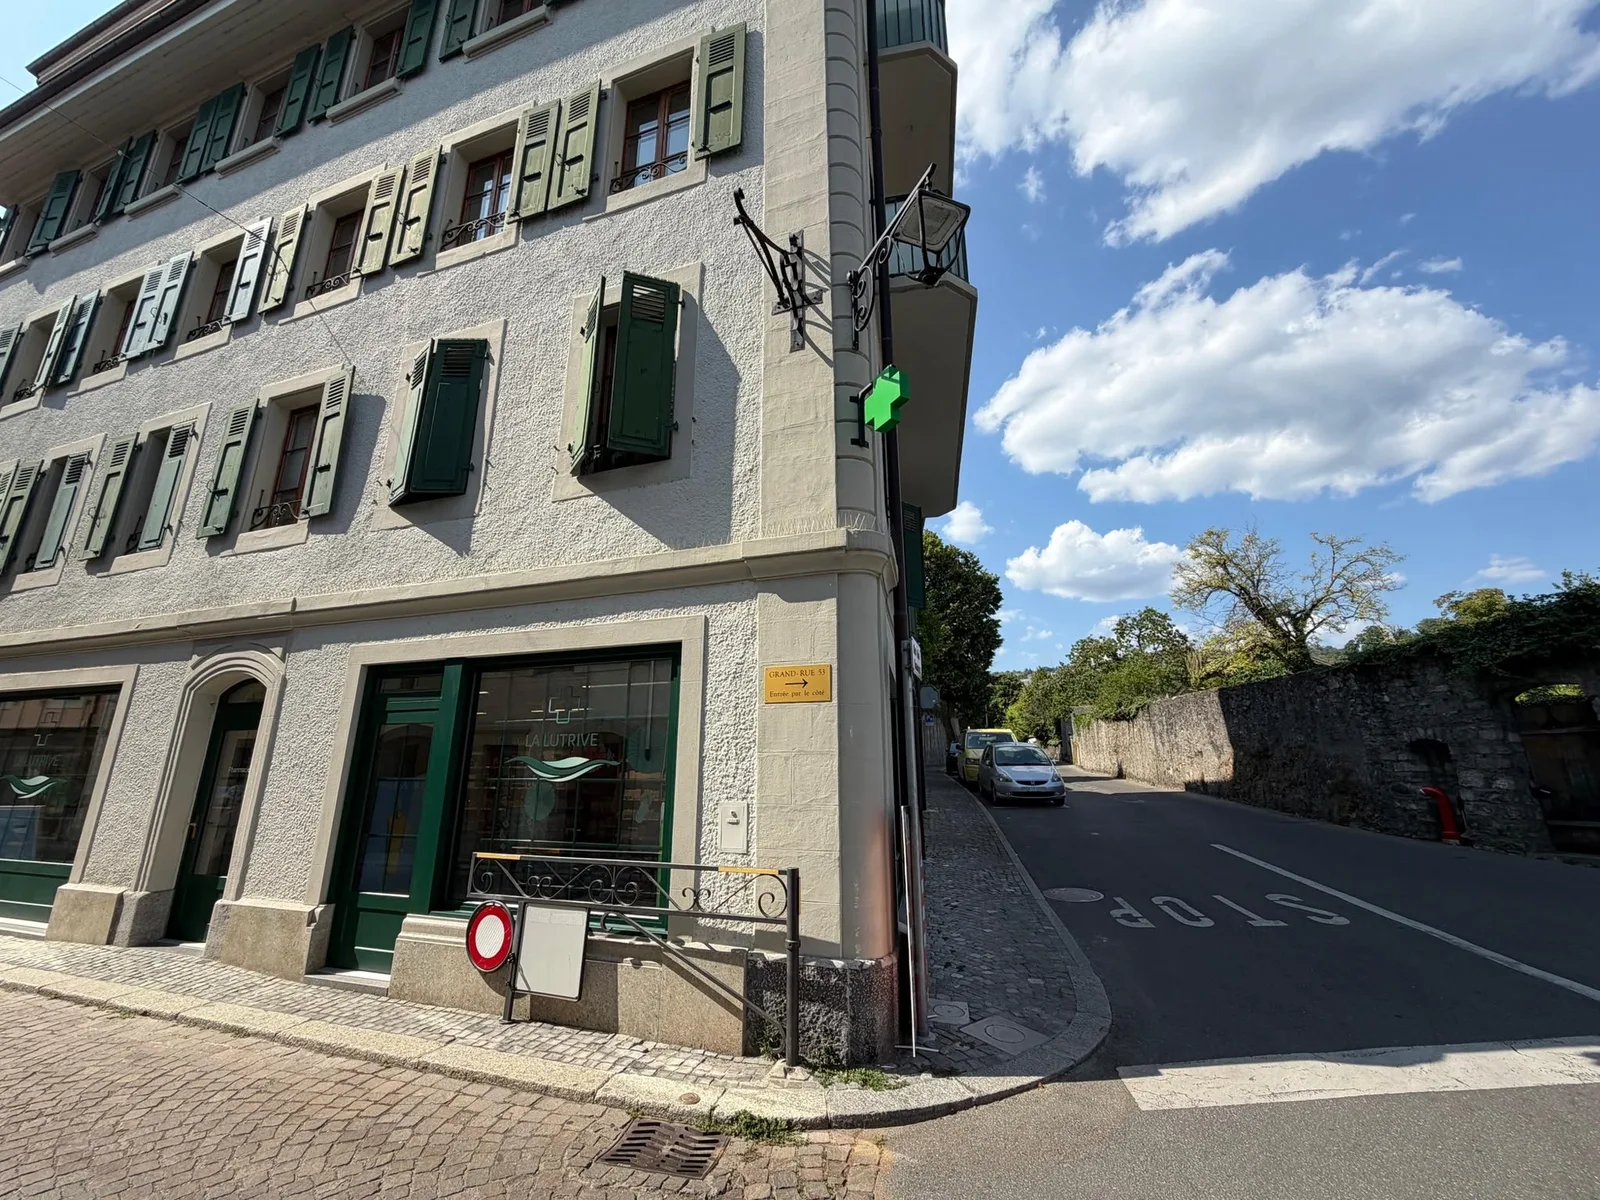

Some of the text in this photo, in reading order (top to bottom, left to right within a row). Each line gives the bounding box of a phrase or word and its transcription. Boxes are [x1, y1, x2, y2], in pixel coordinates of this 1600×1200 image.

[525, 733, 599, 748] LA LUTRIVE
[1110, 893, 1350, 928] STOP
